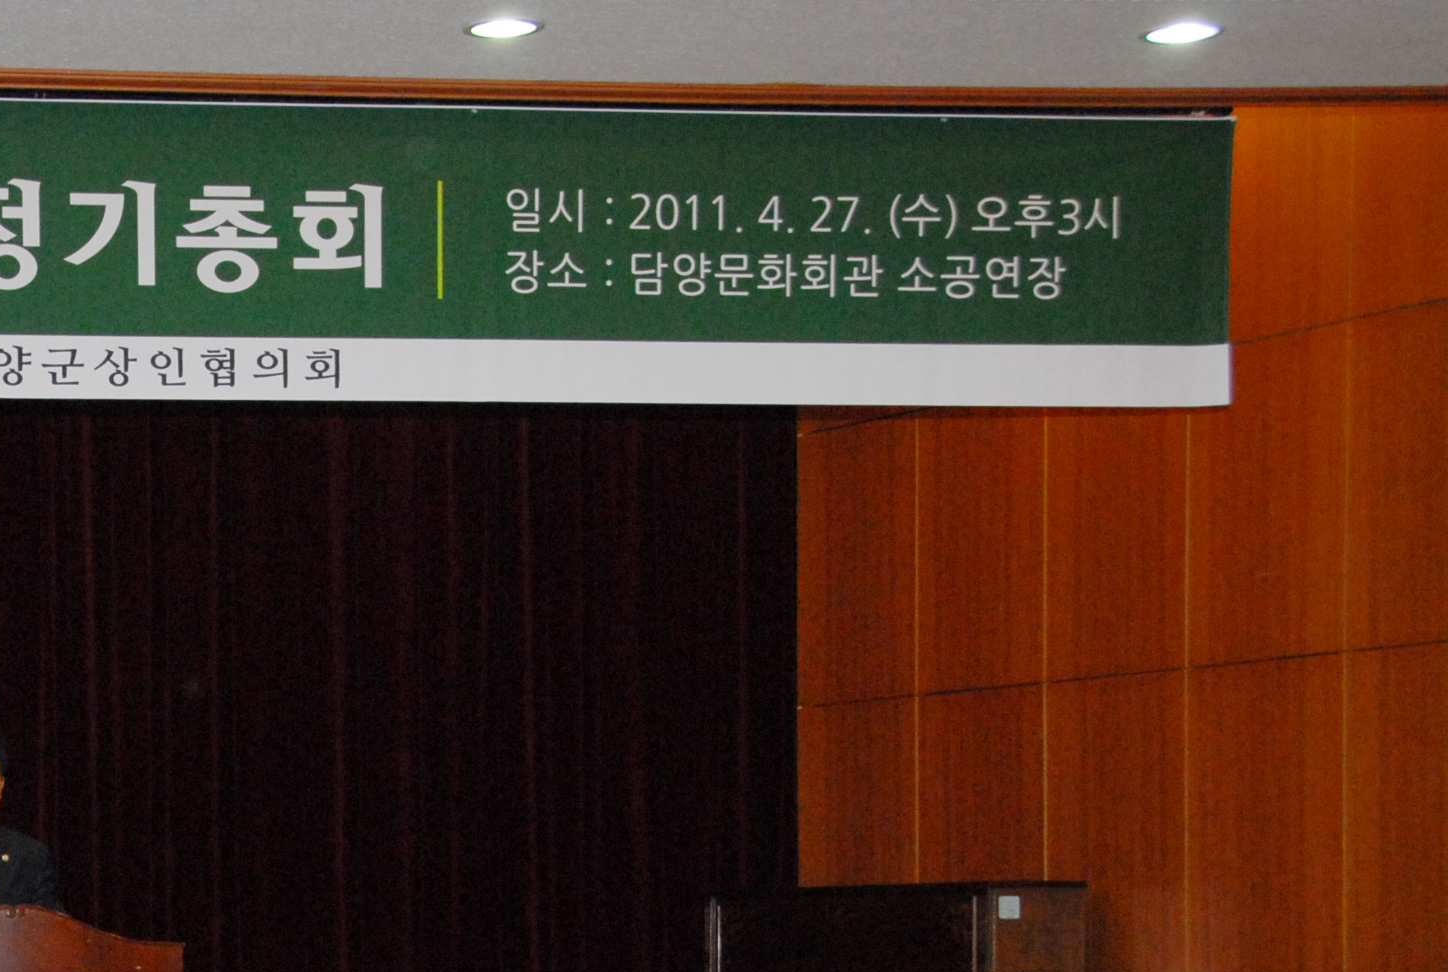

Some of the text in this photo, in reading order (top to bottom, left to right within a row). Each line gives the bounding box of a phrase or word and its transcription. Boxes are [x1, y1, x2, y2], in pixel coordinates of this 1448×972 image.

[506, 188, 586, 235] 일시
[629, 193, 744, 234] 2011.
[758, 195, 795, 235] 4.
[810, 196, 873, 236] 27.
[889, 193, 958, 240] (수)
[972, 194, 1121, 240] 오후3시
[505, 250, 588, 295] 장소
[630, 252, 885, 299] 담양문화회관
[898, 255, 1067, 301] 소공연장
